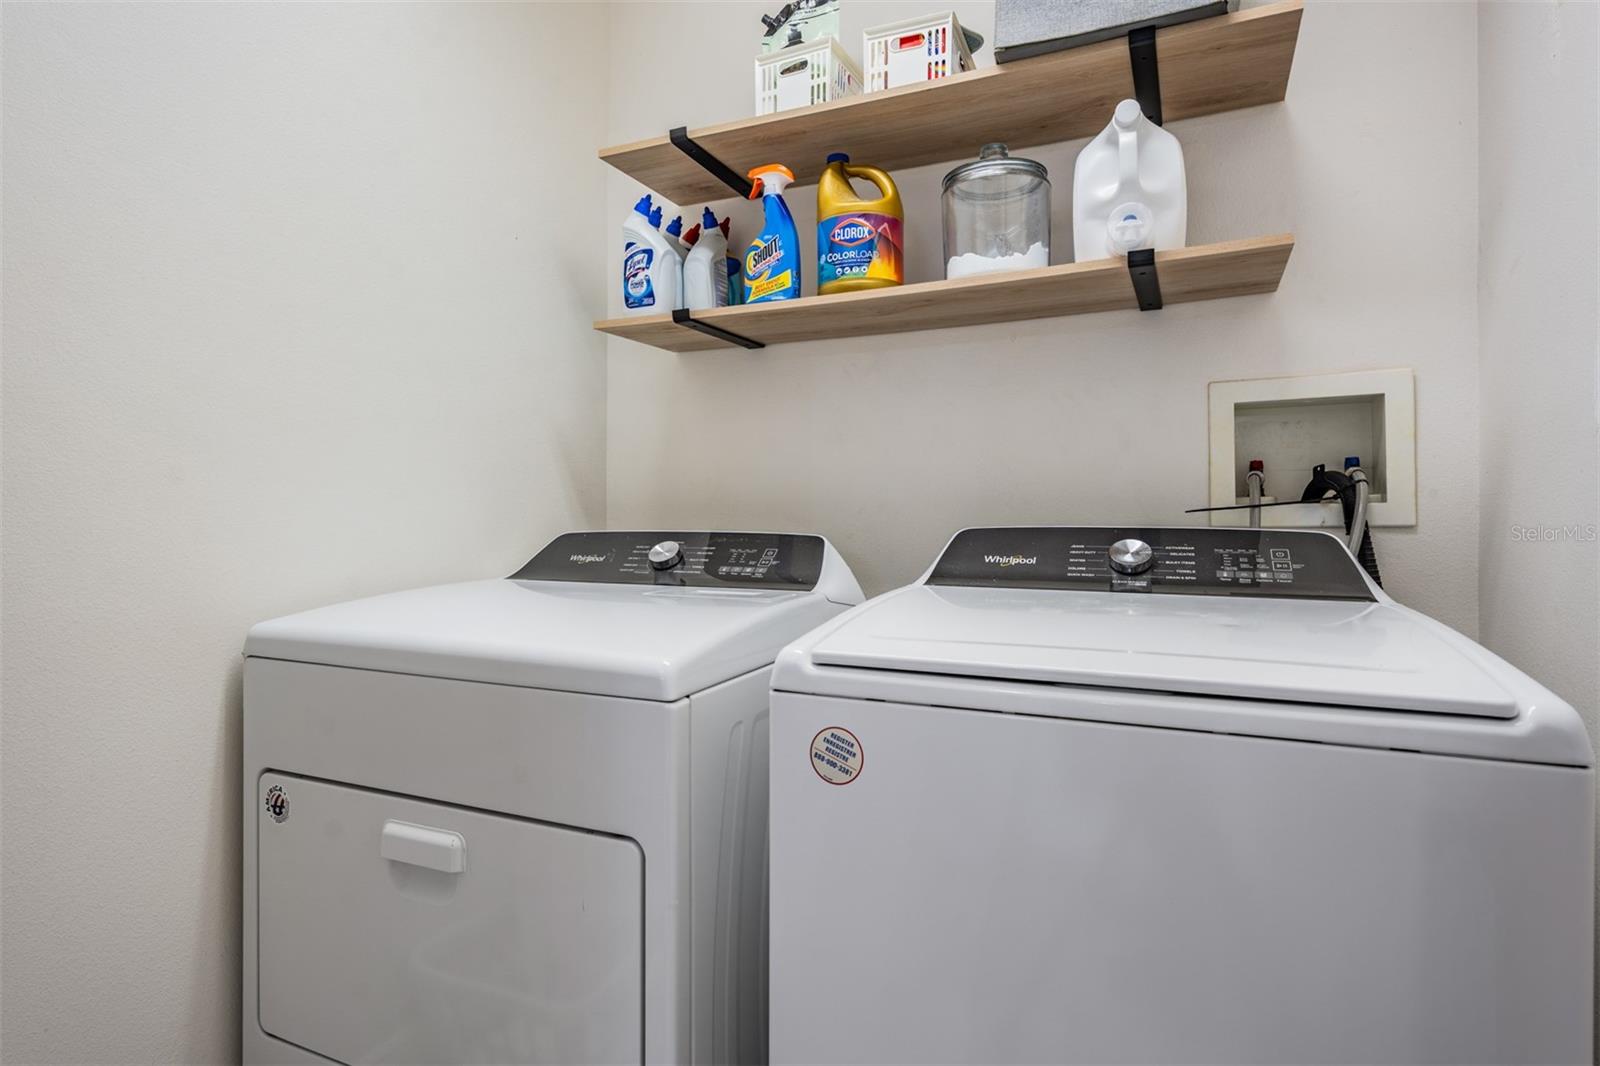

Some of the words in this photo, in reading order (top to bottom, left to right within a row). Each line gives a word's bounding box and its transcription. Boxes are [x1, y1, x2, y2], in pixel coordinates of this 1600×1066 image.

[834, 226, 869, 241] CLOROX
[752, 238, 779, 268] SHOUT
[569, 553, 606, 565] Whirlpool
[984, 554, 1037, 567] Whirlpool
[823, 737, 856, 758] ENREGISTRER
[831, 733, 854, 748] REGISTER
